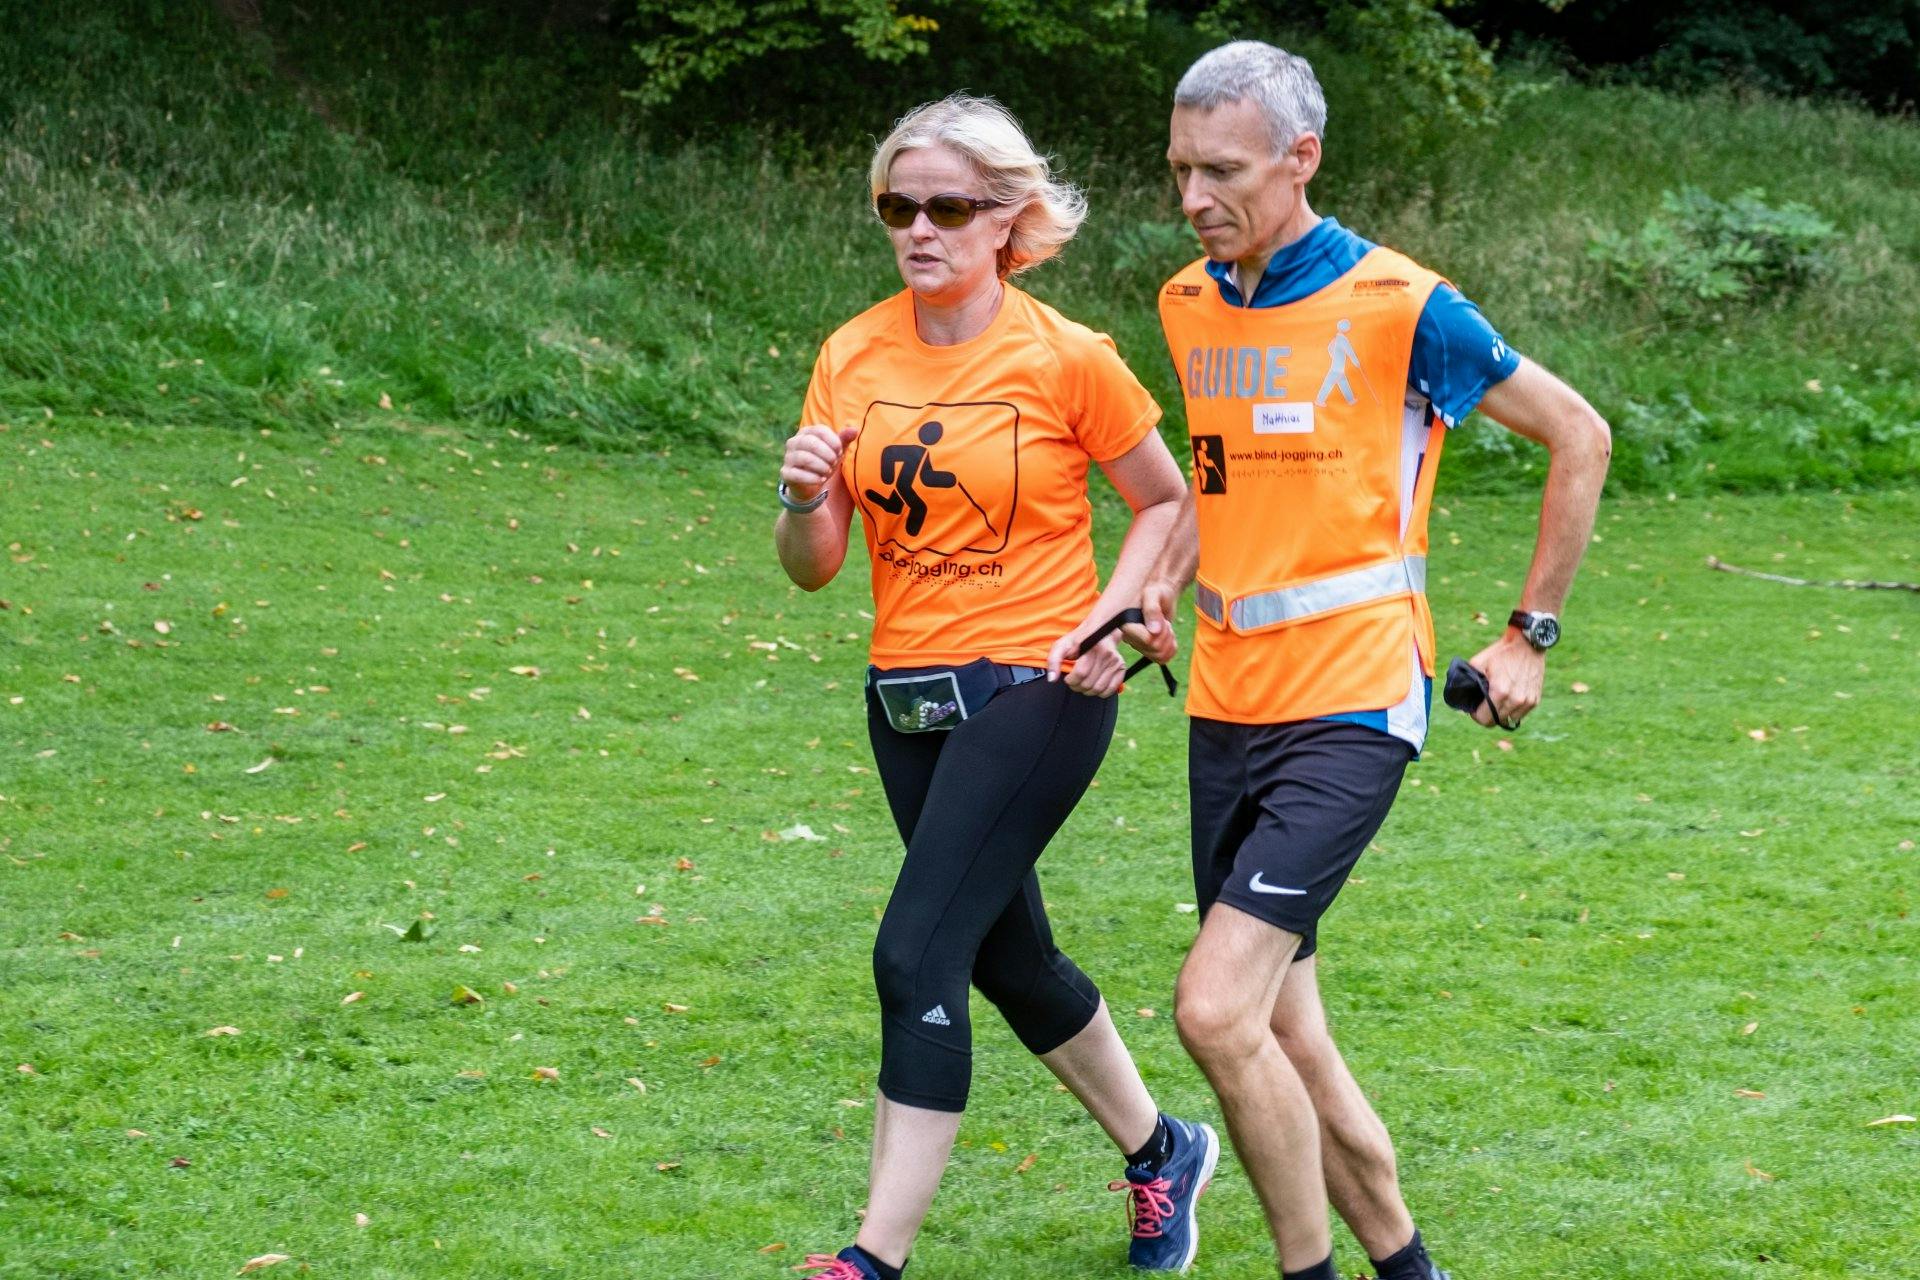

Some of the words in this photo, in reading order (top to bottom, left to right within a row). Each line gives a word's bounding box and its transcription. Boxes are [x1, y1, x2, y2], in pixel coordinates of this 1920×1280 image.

[1188, 347, 1291, 398] GUIDE
[1229, 449, 1343, 463] www.blind-jogging.ch
[922, 1014, 951, 1026] adidas
